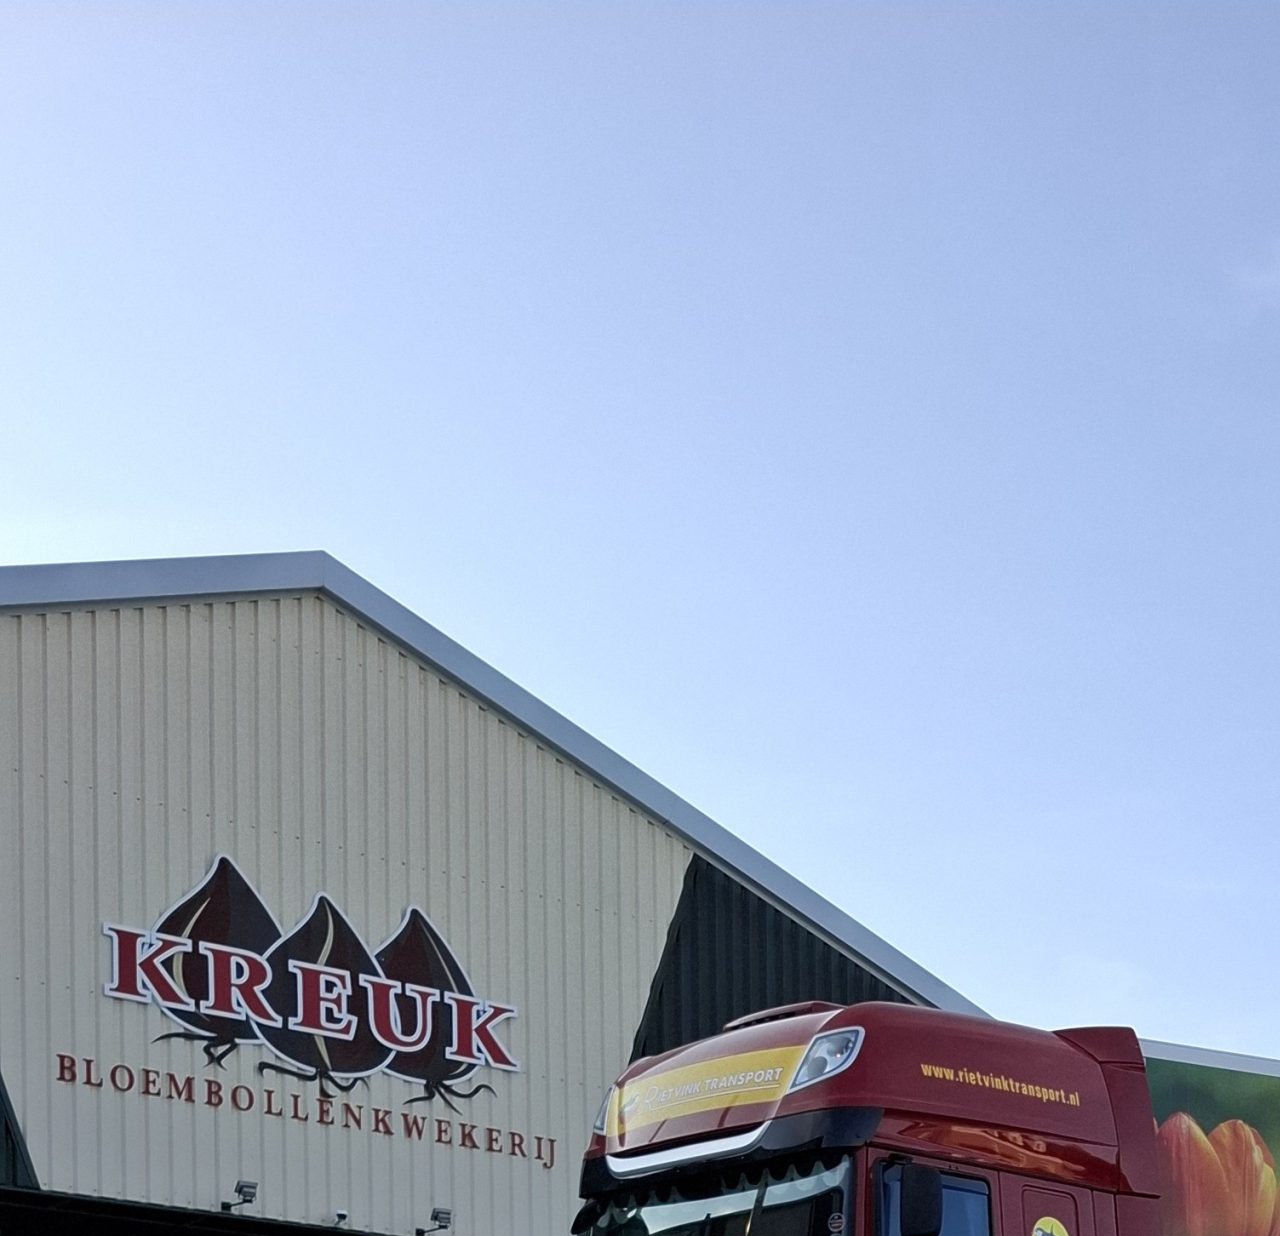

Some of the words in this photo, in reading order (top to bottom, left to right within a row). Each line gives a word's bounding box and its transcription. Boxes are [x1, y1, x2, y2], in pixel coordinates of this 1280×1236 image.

[104, 922, 520, 1073] KREUK
[56, 1053, 558, 1170] BLOEMBOLLENKWEKERIJ
[704, 1067, 784, 1092] TRANSPORT
[920, 1063, 1081, 1107] www.rietvinktransport.nl
